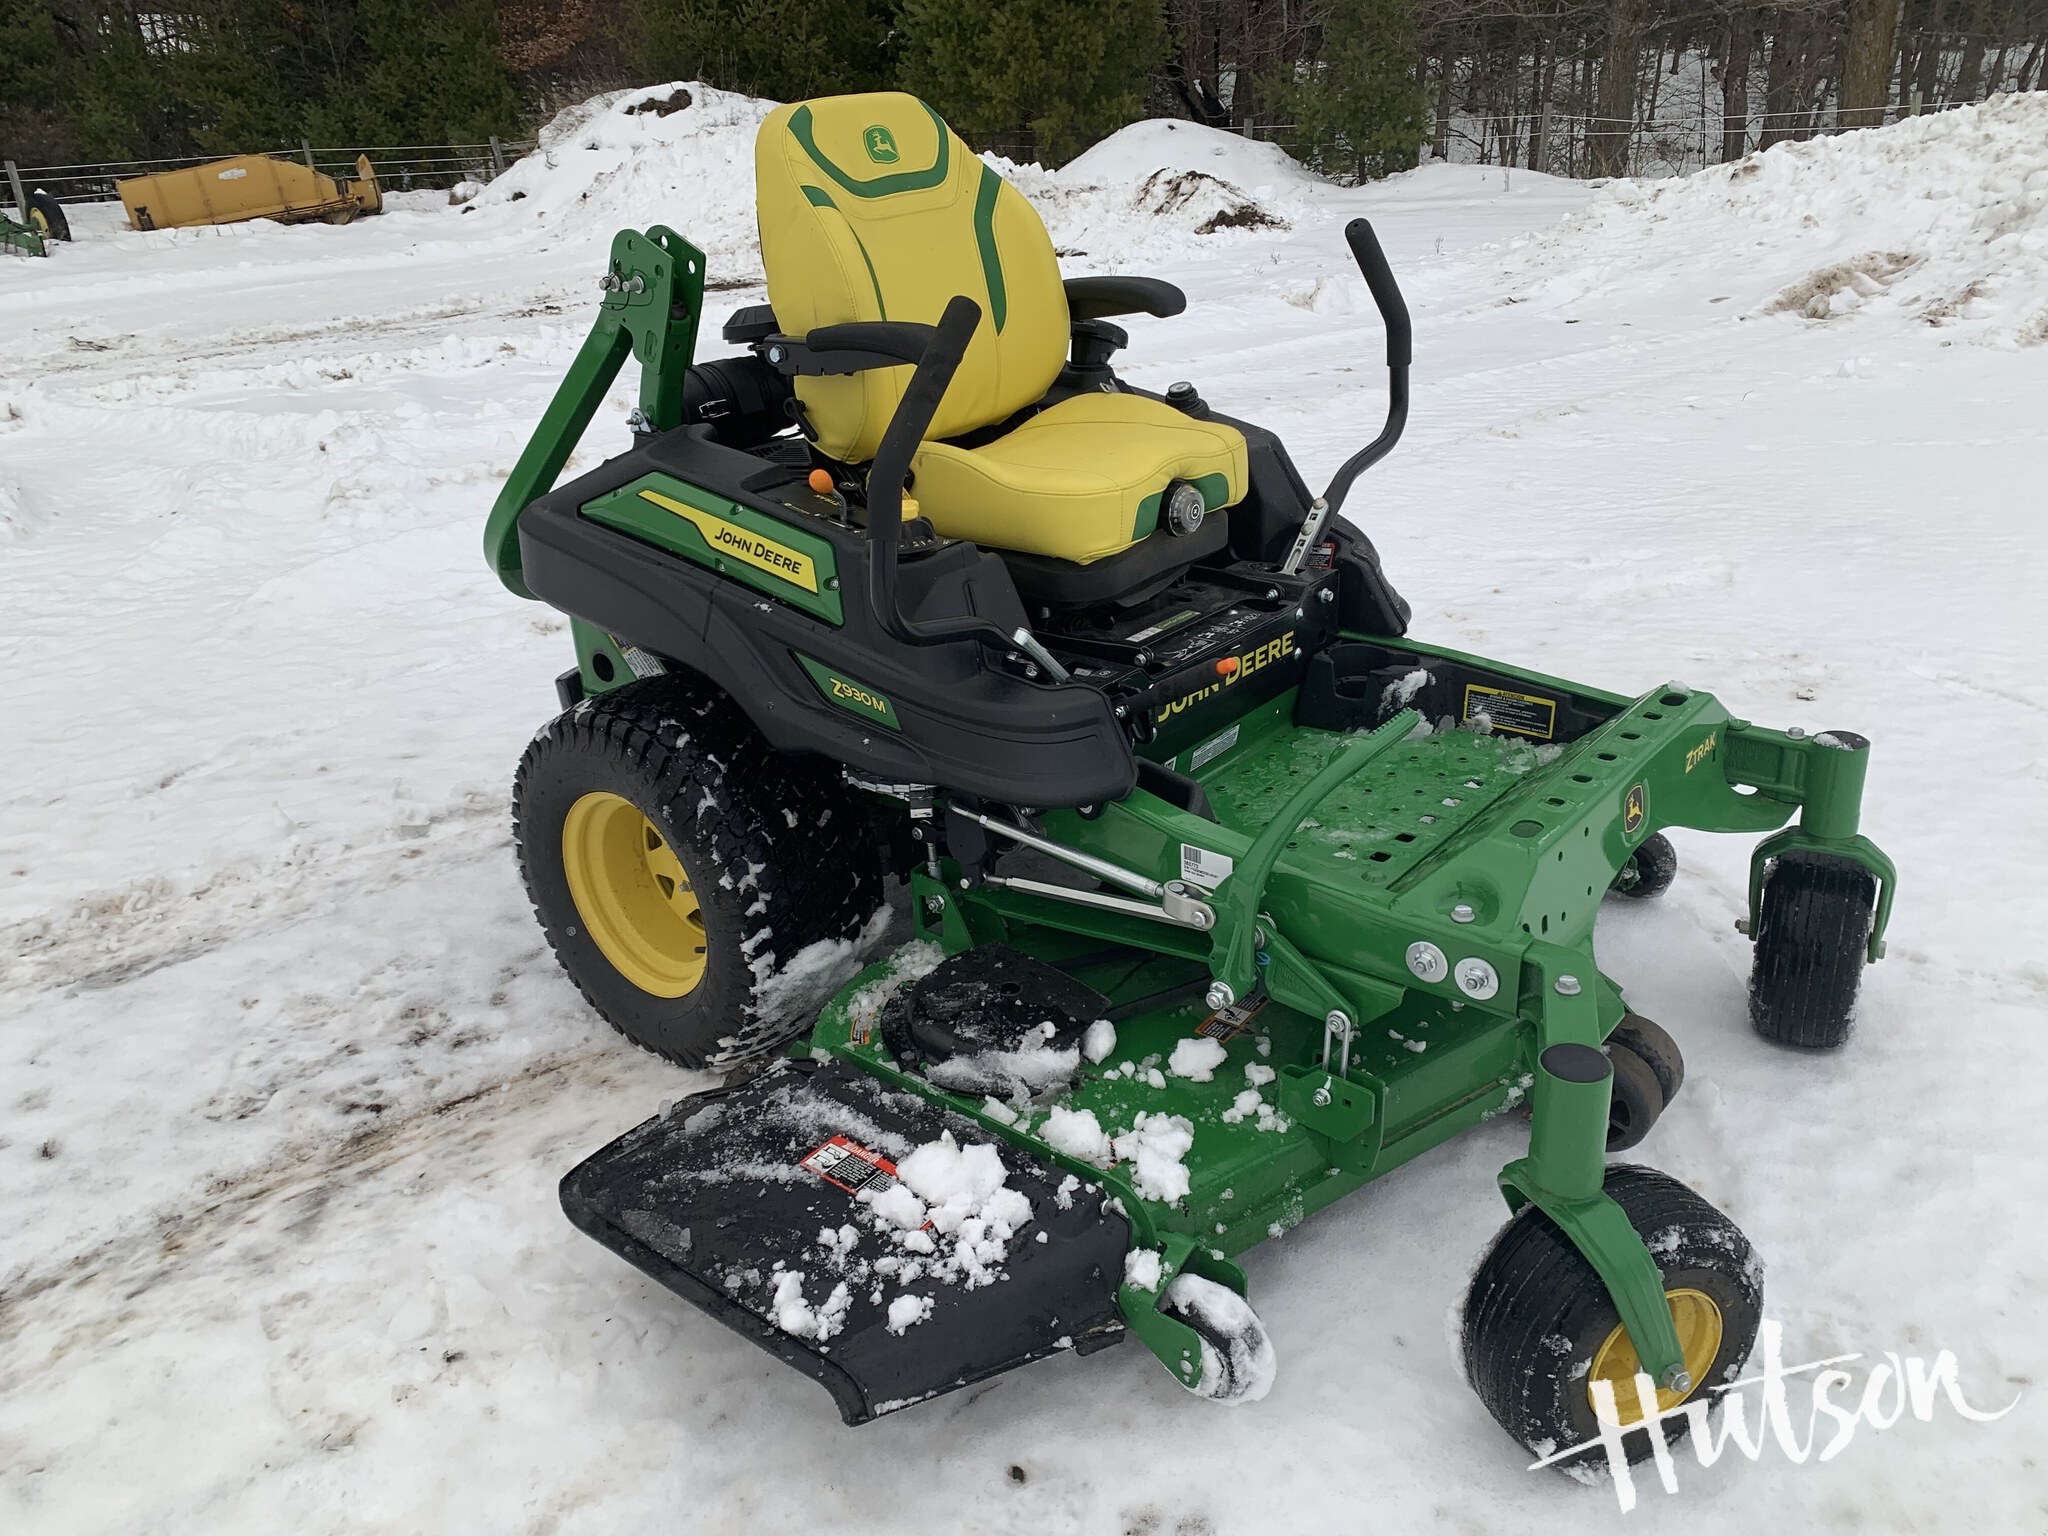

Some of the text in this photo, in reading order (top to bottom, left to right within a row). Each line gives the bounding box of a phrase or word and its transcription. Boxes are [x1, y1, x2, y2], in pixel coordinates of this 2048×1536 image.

[714, 527, 802, 575] JOHN DEERE
[1225, 630, 1294, 687] DEERE
[829, 677, 887, 714] Z930M
[1685, 731, 1717, 774] ZTRAK
[852, 1146, 880, 1165] DANGR
